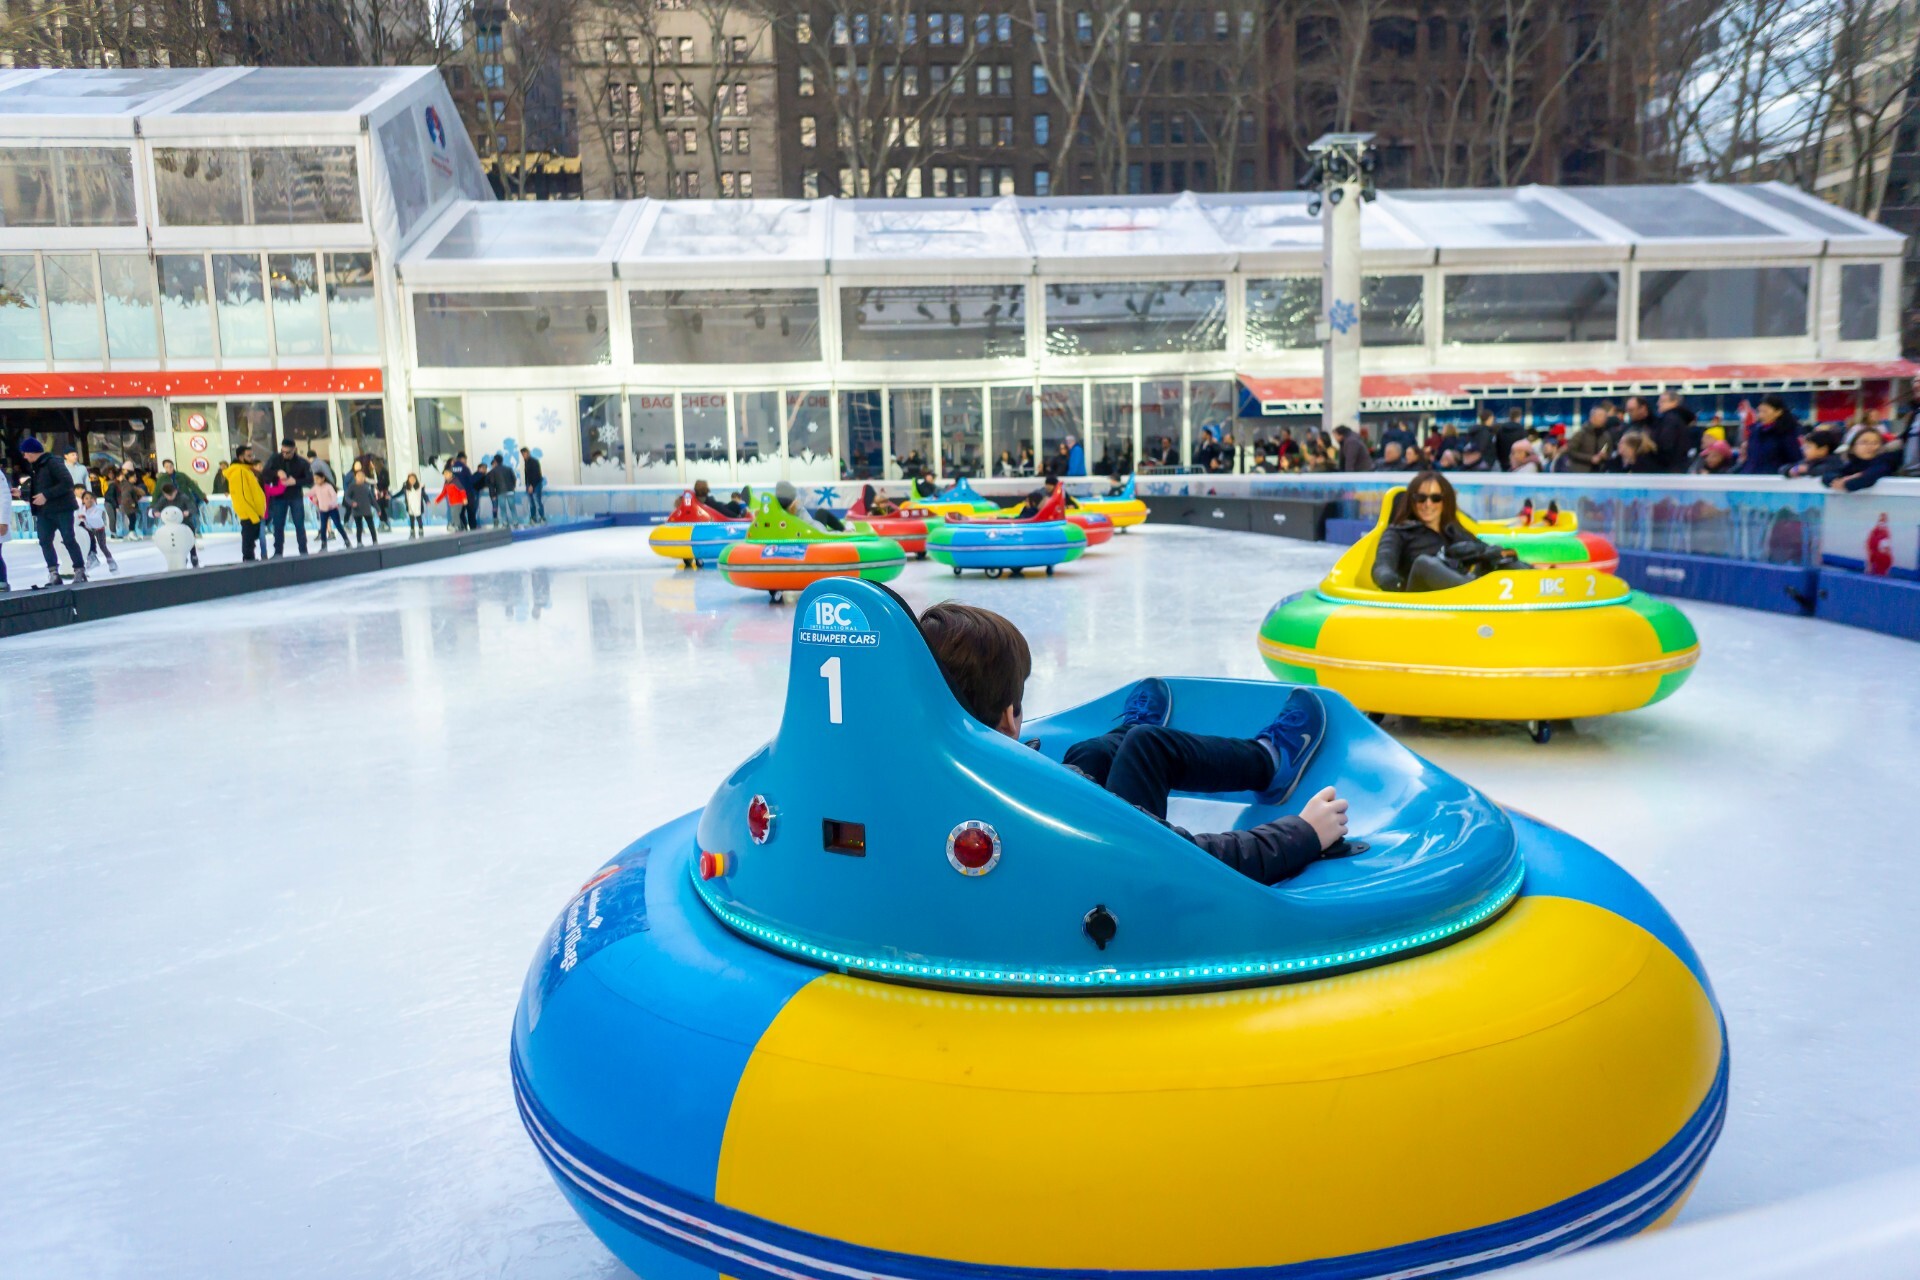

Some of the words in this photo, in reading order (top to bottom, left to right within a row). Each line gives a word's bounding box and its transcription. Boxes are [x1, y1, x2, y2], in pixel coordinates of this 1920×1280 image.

[641, 396, 673, 409] BAG
[763, 503, 770, 514] 6
[1498, 577, 1514, 600] 2
[1539, 577, 1565, 595] IBC
[1585, 574, 1596, 596] 2
[815, 602, 851, 625] IBC
[800, 631, 811, 642] ICE
[812, 632, 847, 644] BUMPER
[848, 634, 876, 645] CARS
[819, 656, 843, 725] 1
[561, 924, 582, 971] Village
